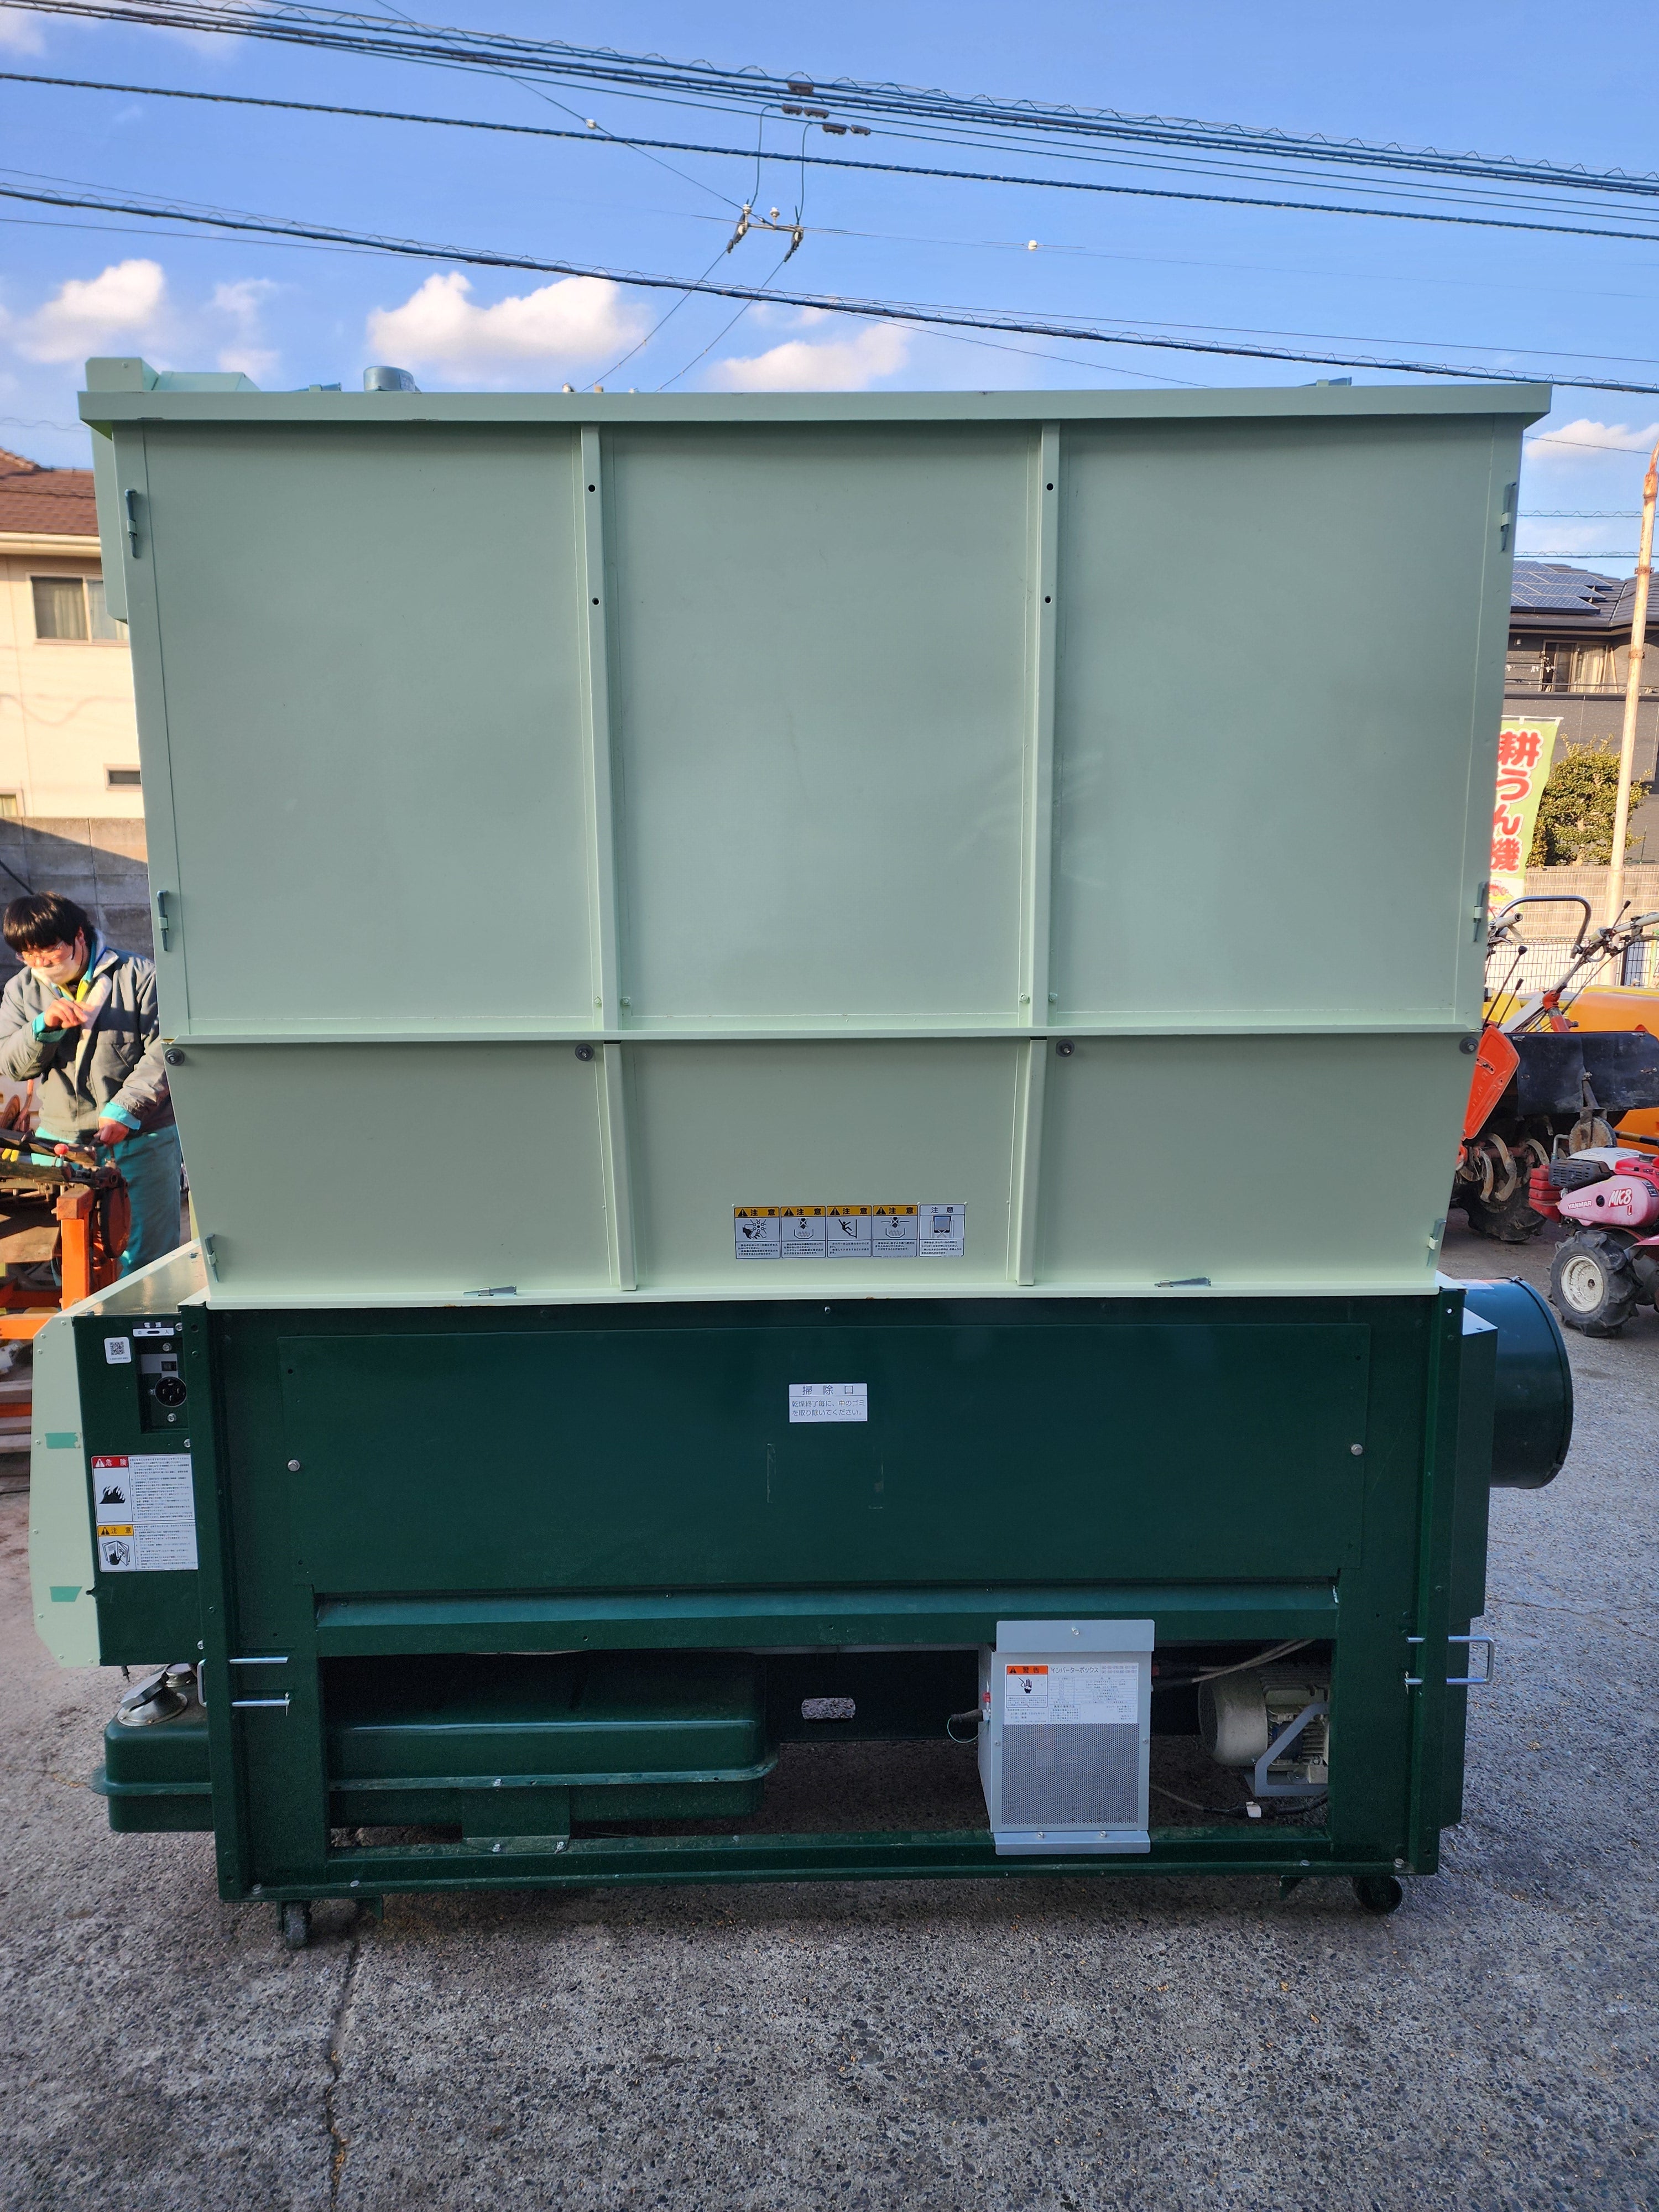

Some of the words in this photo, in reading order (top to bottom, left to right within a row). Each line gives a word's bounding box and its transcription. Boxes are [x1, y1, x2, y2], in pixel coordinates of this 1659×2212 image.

[1490, 731, 1541, 871] 耕うん機
[1608, 1188, 1632, 1207] MK8
[1568, 1201, 1592, 1209] YANMAR
[802, 1385, 853, 1395] 掃除口
